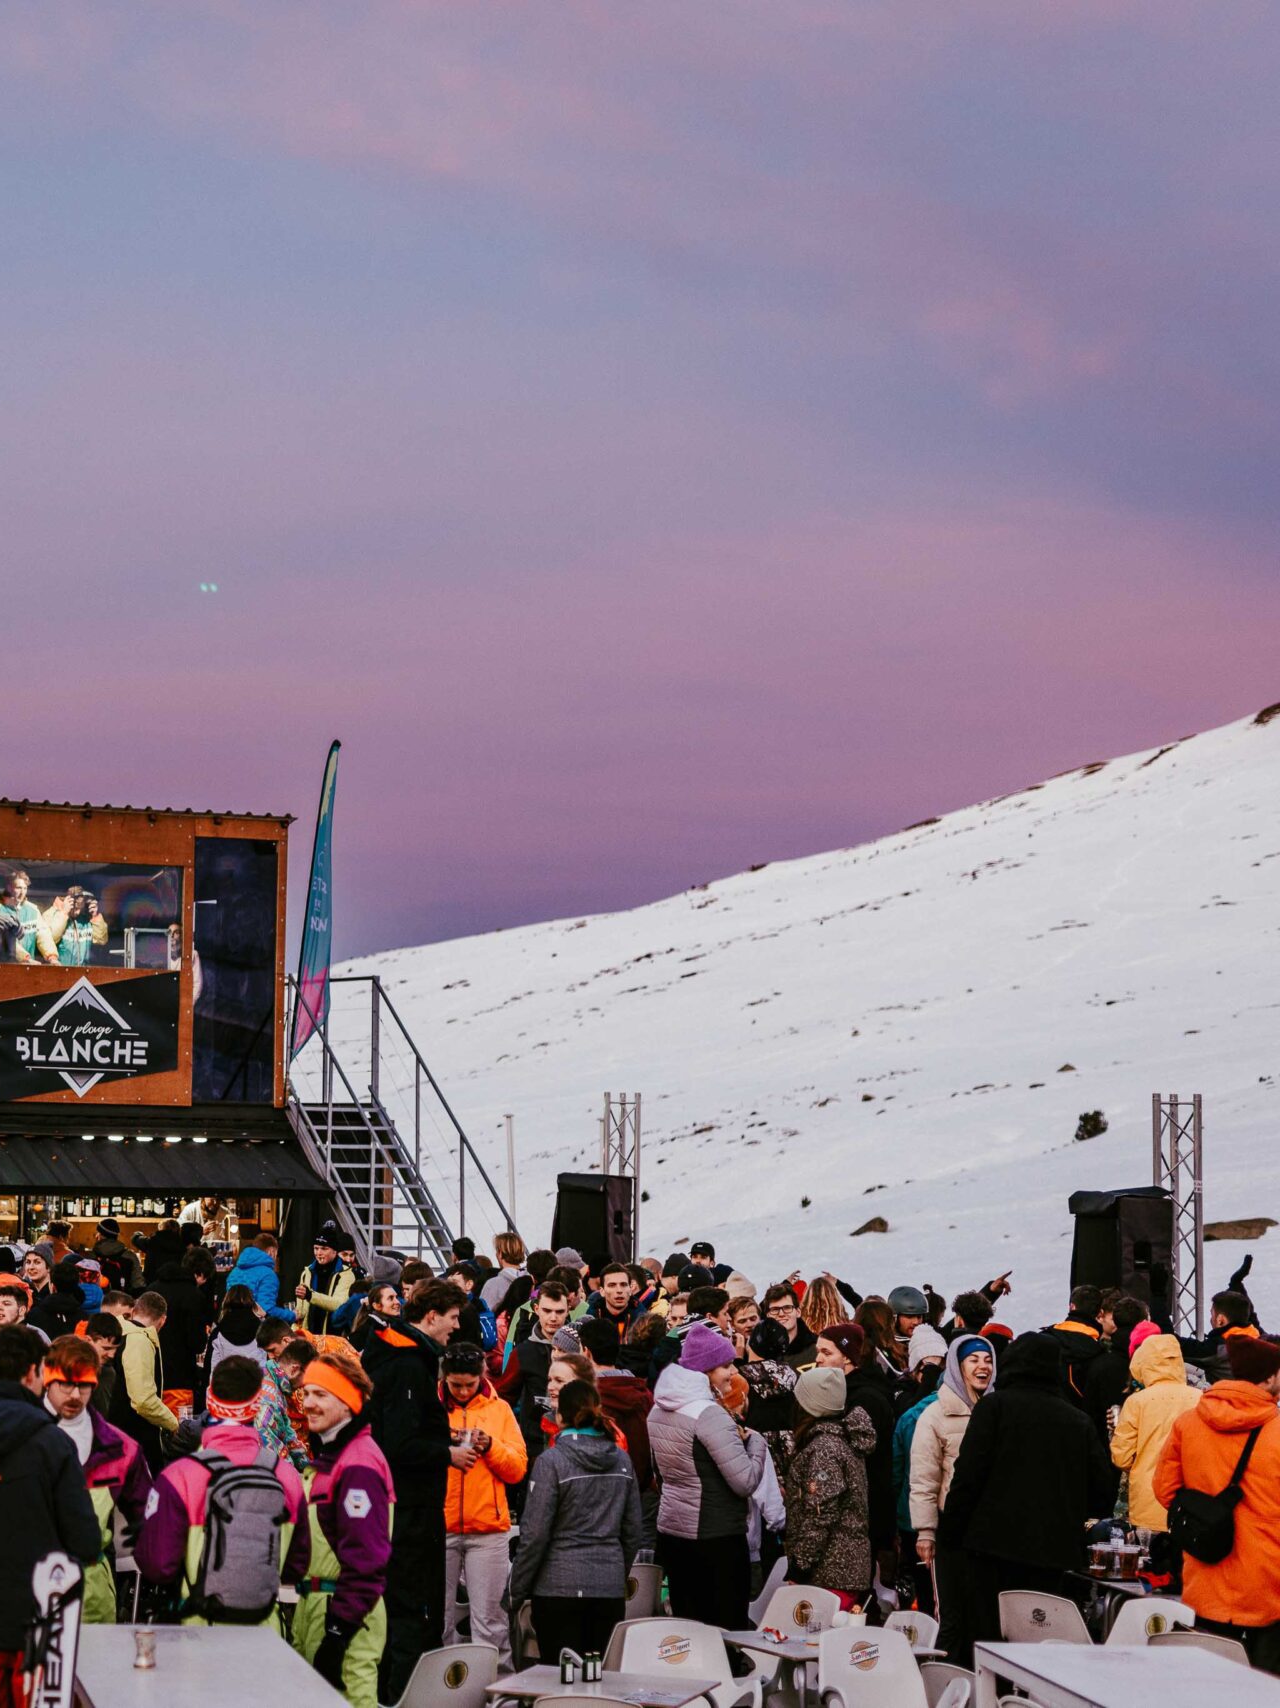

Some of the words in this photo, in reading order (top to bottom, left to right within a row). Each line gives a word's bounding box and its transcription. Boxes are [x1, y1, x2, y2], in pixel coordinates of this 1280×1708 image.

[52, 1019, 72, 1034] La
[72, 1021, 114, 1040] plage
[15, 1036, 149, 1065] BLANCHE
